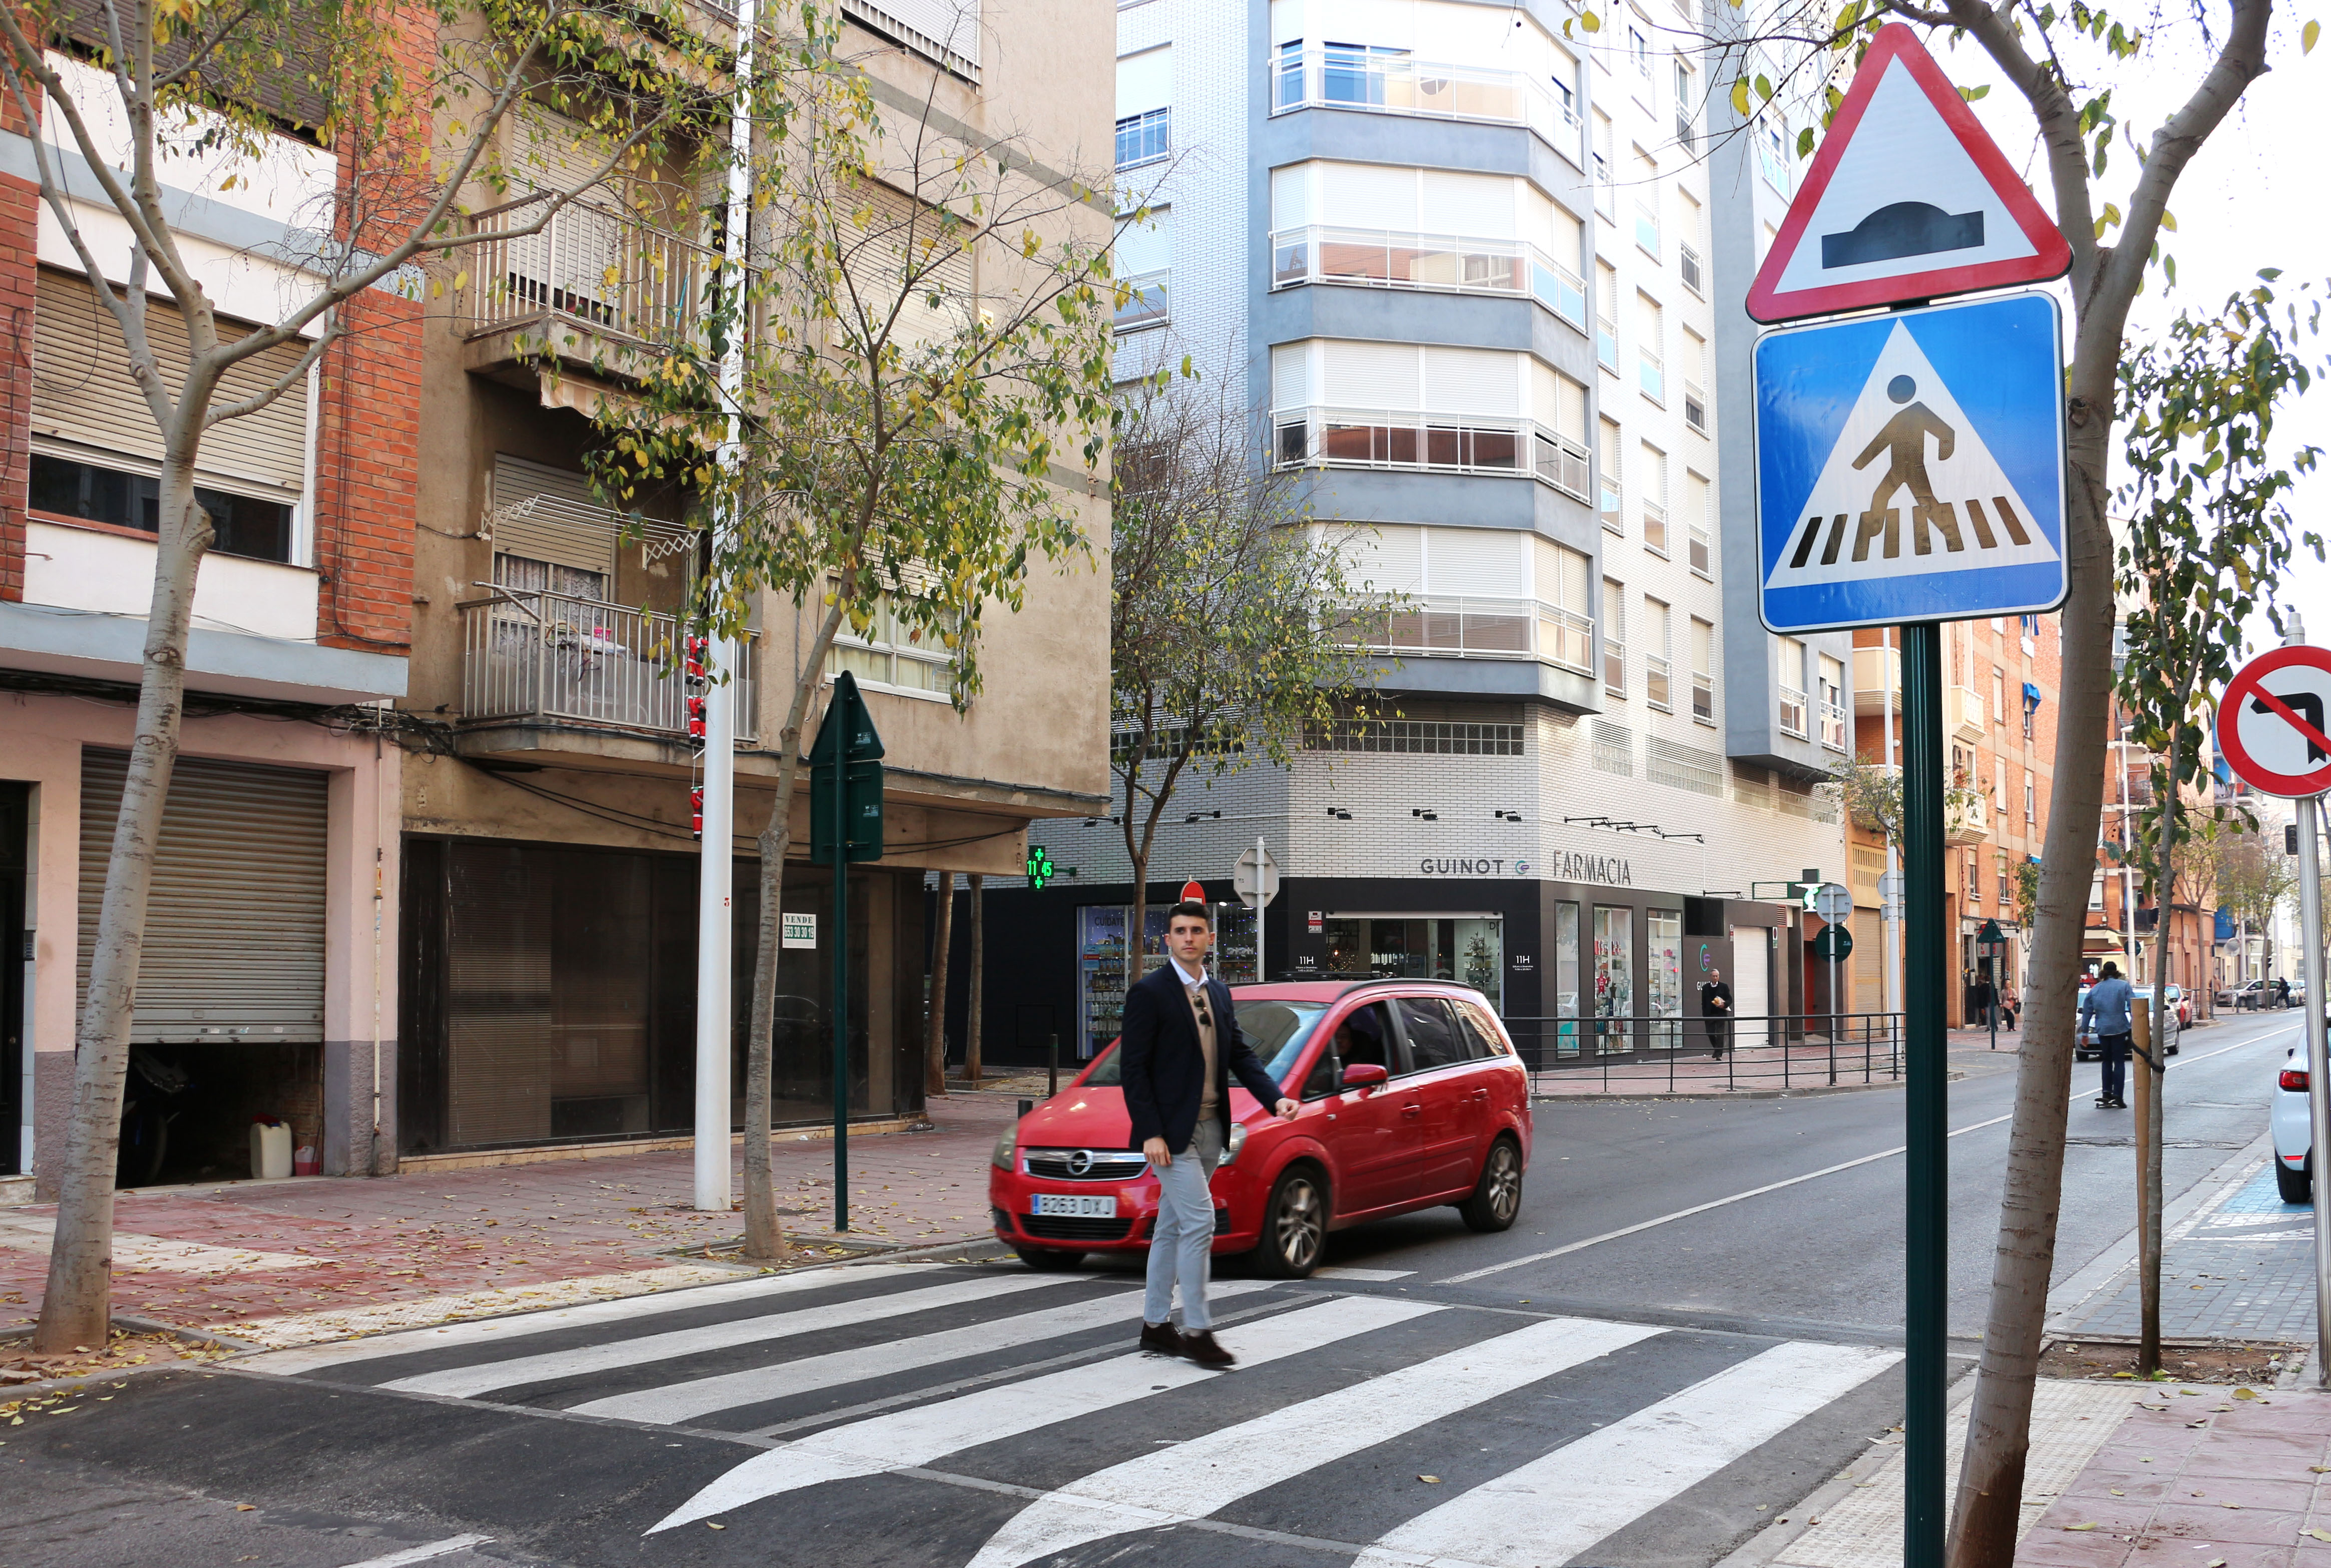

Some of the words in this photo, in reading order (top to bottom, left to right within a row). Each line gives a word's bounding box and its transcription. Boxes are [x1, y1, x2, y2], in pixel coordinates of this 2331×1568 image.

[1027, 860, 1037, 875] 11
[1420, 859, 1504, 874] GUINOT
[1553, 850, 1632, 885] FARMACIA
[785, 915, 813, 924] VENDE
[784, 926, 794, 938] 653
[794, 926, 801, 938] 30
[801, 926, 808, 938] 30
[808, 927, 814, 938] 19
[1299, 956, 1314, 964] 11H
[1516, 955, 1530, 964] 11H
[1081, 1198, 1113, 1216] DXJ
